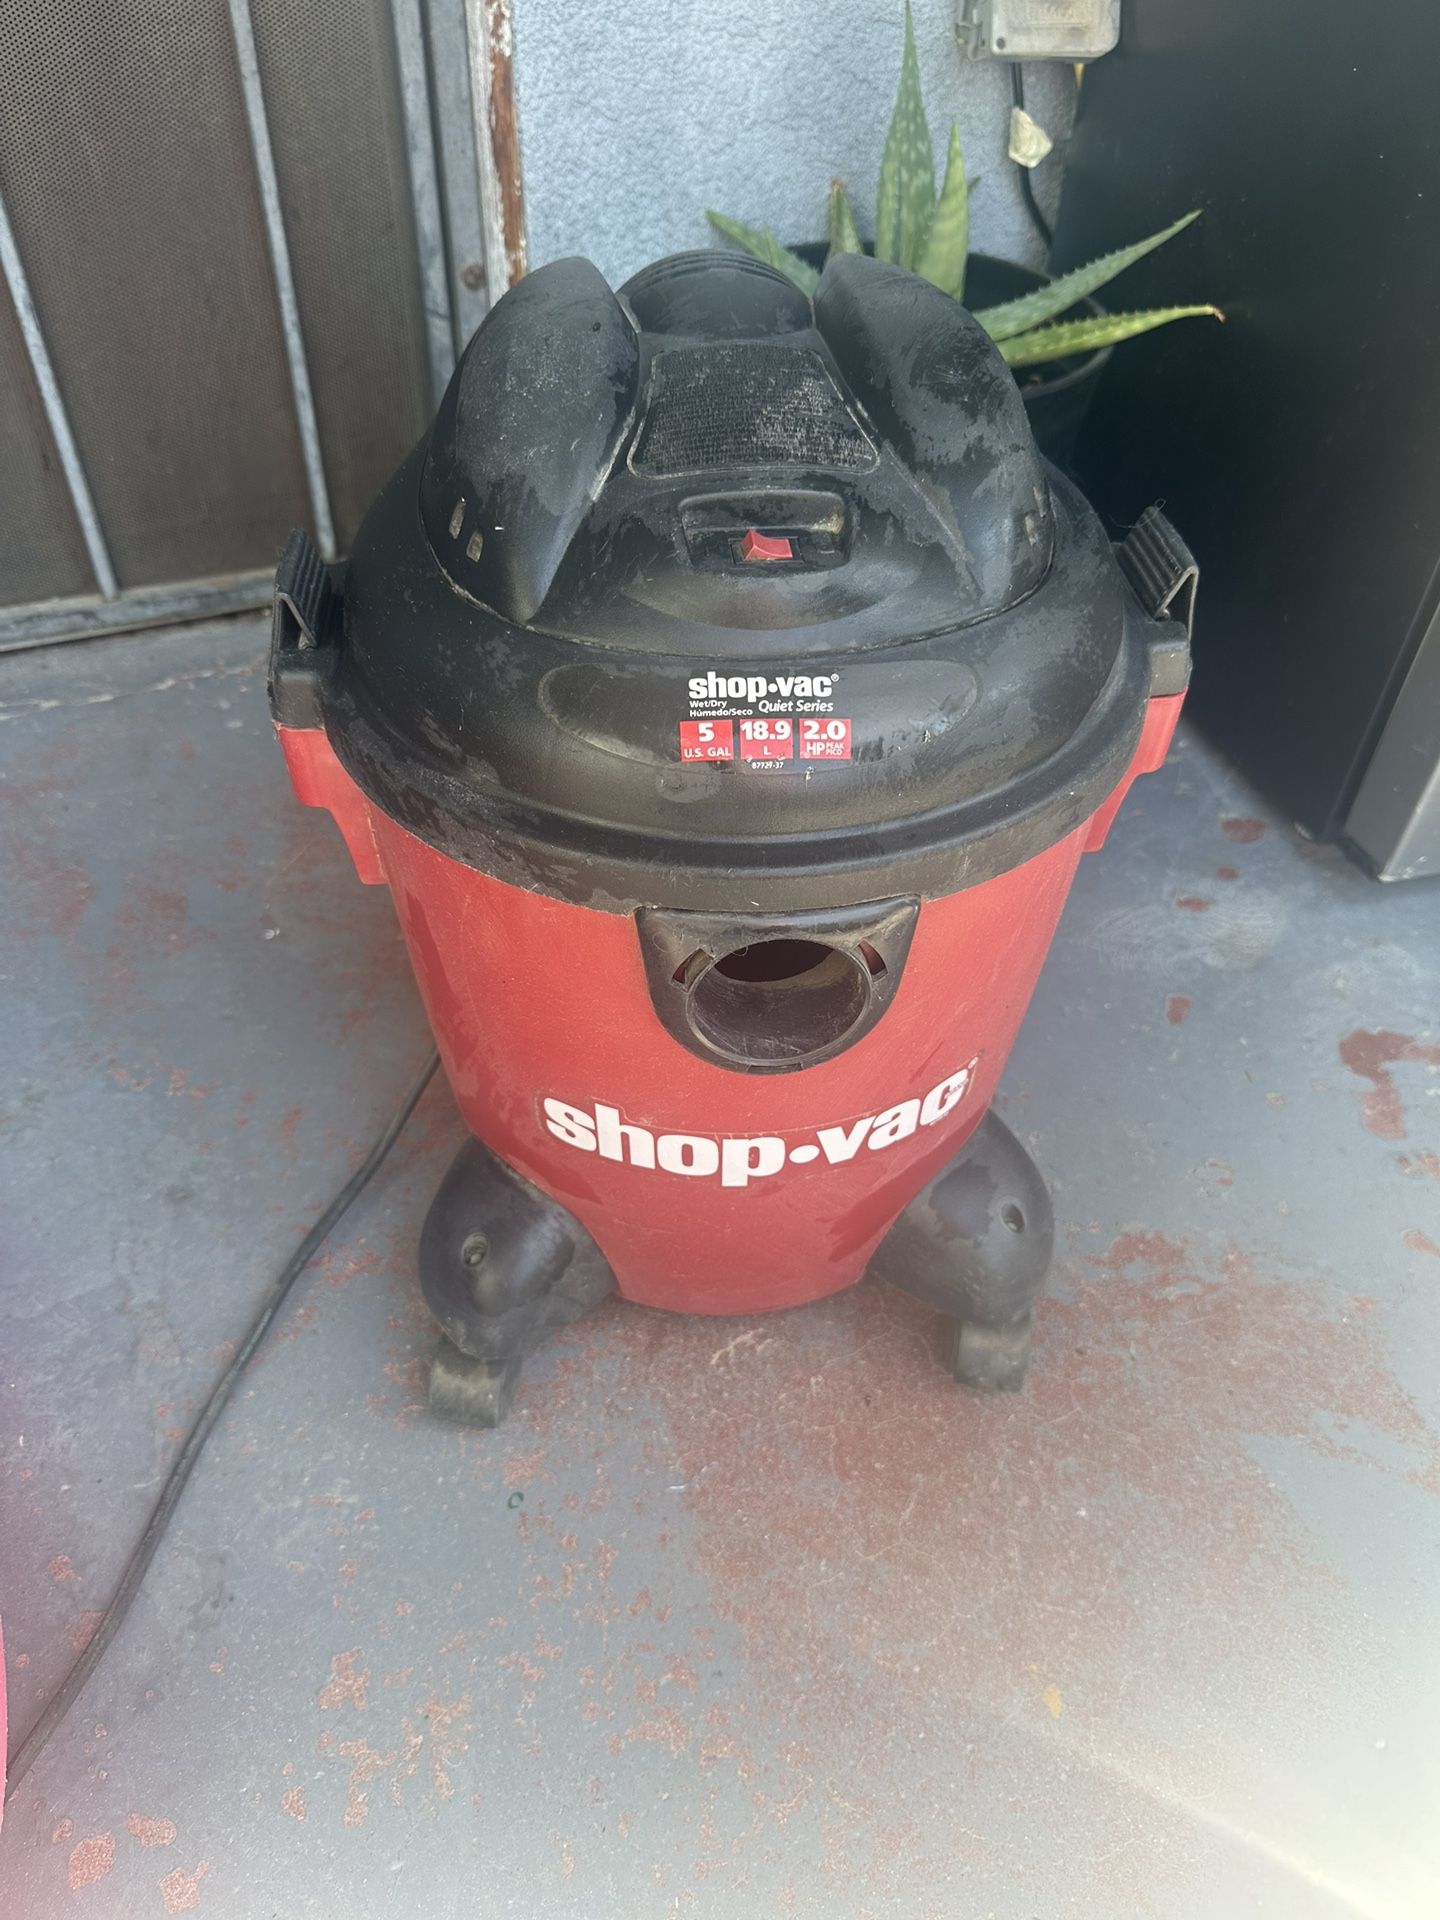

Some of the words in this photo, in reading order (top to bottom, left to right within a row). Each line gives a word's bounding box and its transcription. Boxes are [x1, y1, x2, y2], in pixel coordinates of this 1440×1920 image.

[689, 700, 728, 708] Wet/Dry
[758, 700, 794, 712] Quiet
[796, 700, 834, 712] Series
[698, 722, 715, 742] 5
[740, 720, 791, 740] 18.9
[803, 720, 847, 740] 2.0
[763, 745, 772, 756] L
[806, 742, 825, 755] HP
[825, 742, 844, 750] PEAK
[684, 747, 704, 758] U.S.
[707, 747, 732, 757] GAL
